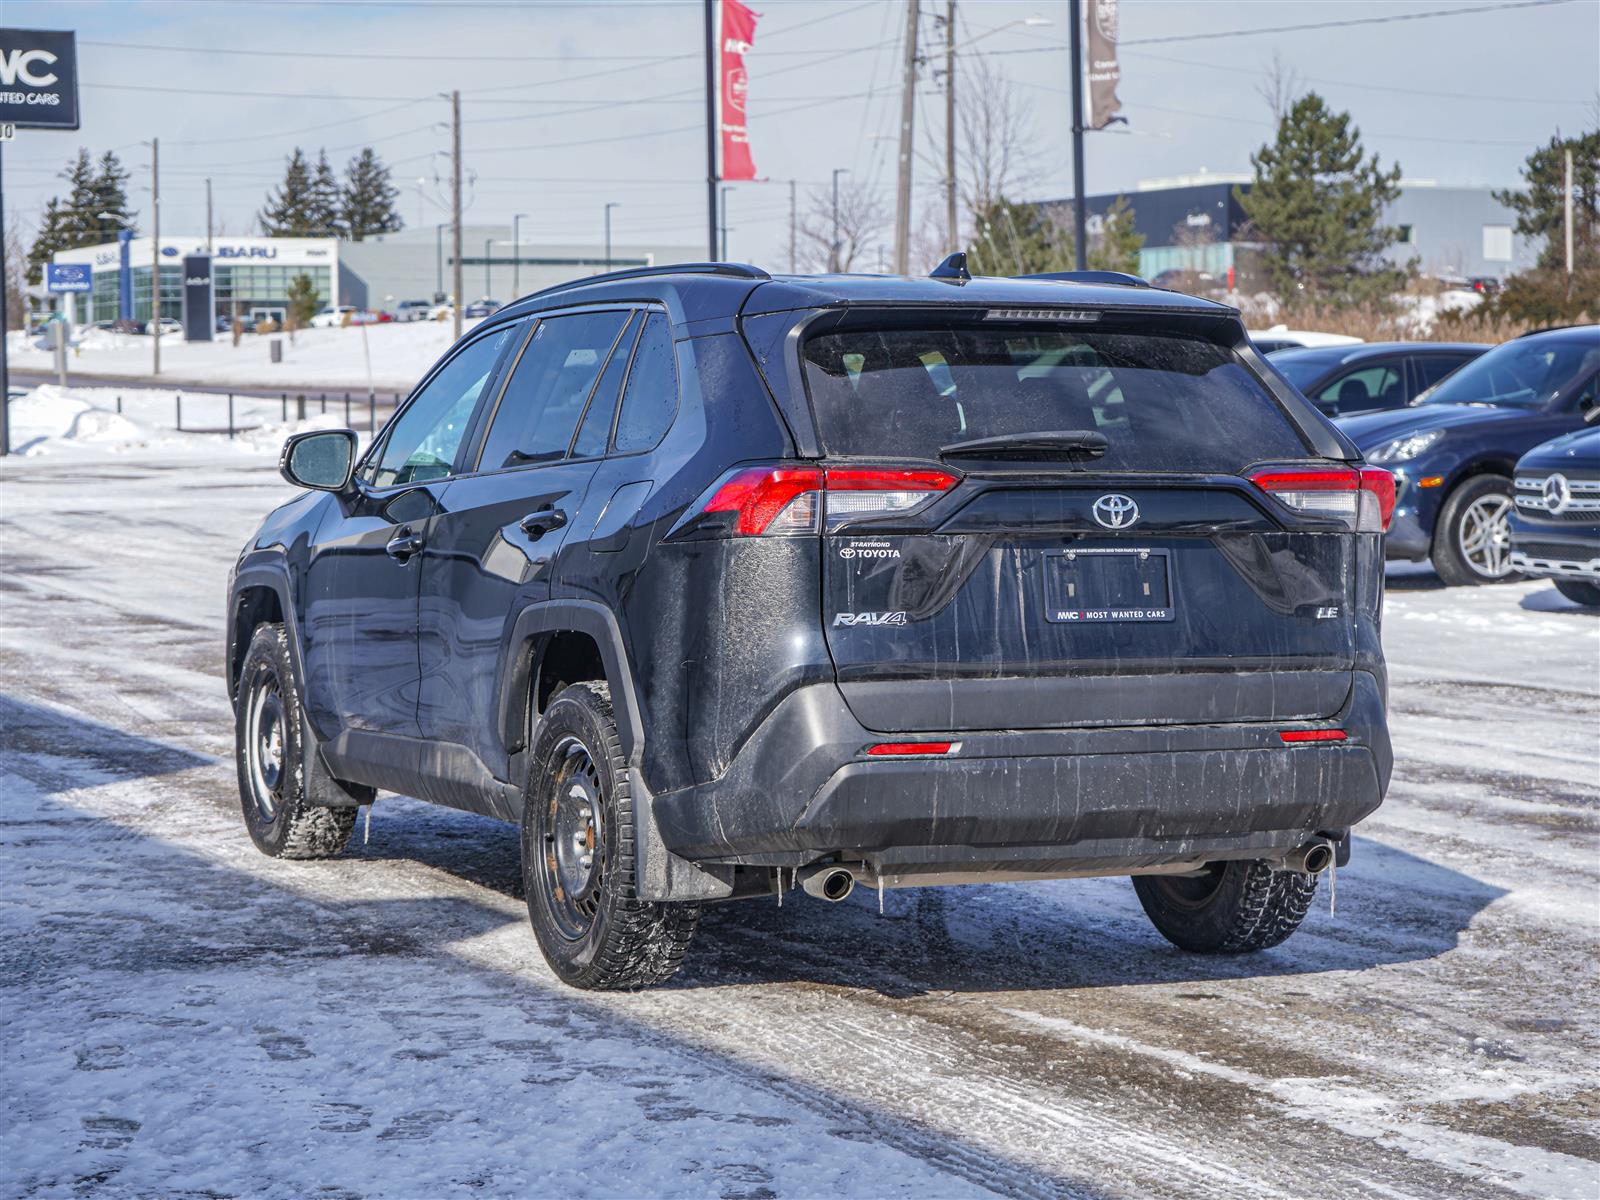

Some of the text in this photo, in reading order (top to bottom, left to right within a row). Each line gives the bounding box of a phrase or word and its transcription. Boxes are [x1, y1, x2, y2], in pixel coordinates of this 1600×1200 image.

[26, 93, 60, 106] CARS
[198, 246, 277, 259] UBARU
[857, 549, 901, 558] TOYOTA
[832, 611, 907, 626] RAV4
[1086, 611, 1108, 619] MOST
[1111, 611, 1144, 619] WANTED
[1146, 610, 1166, 618] CARS
[1316, 607, 1339, 618] LE
